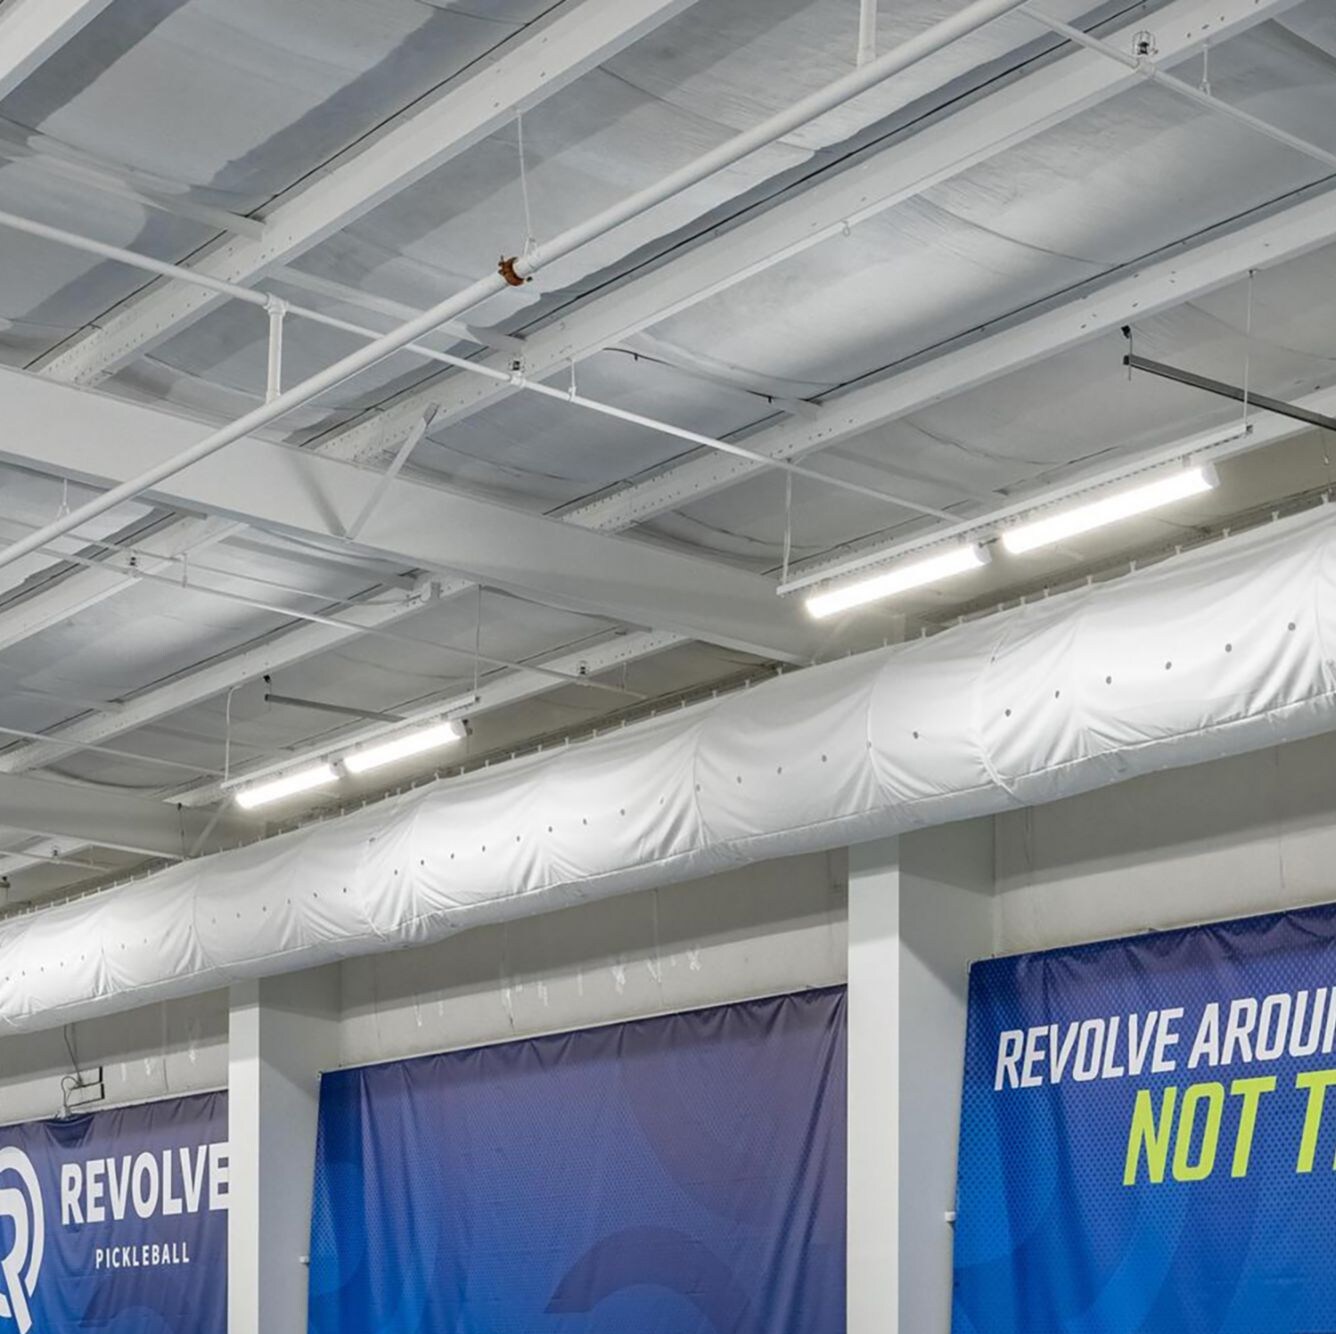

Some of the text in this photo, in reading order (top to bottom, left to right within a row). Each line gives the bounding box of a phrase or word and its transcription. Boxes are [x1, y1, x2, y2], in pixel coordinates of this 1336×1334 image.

[994, 1007, 1184, 1091] REVOLVE
[1122, 1069, 1336, 1186] NOT T
[61, 1141, 229, 1226] REVOLVE
[95, 1241, 190, 1269] PICKLEBALL
